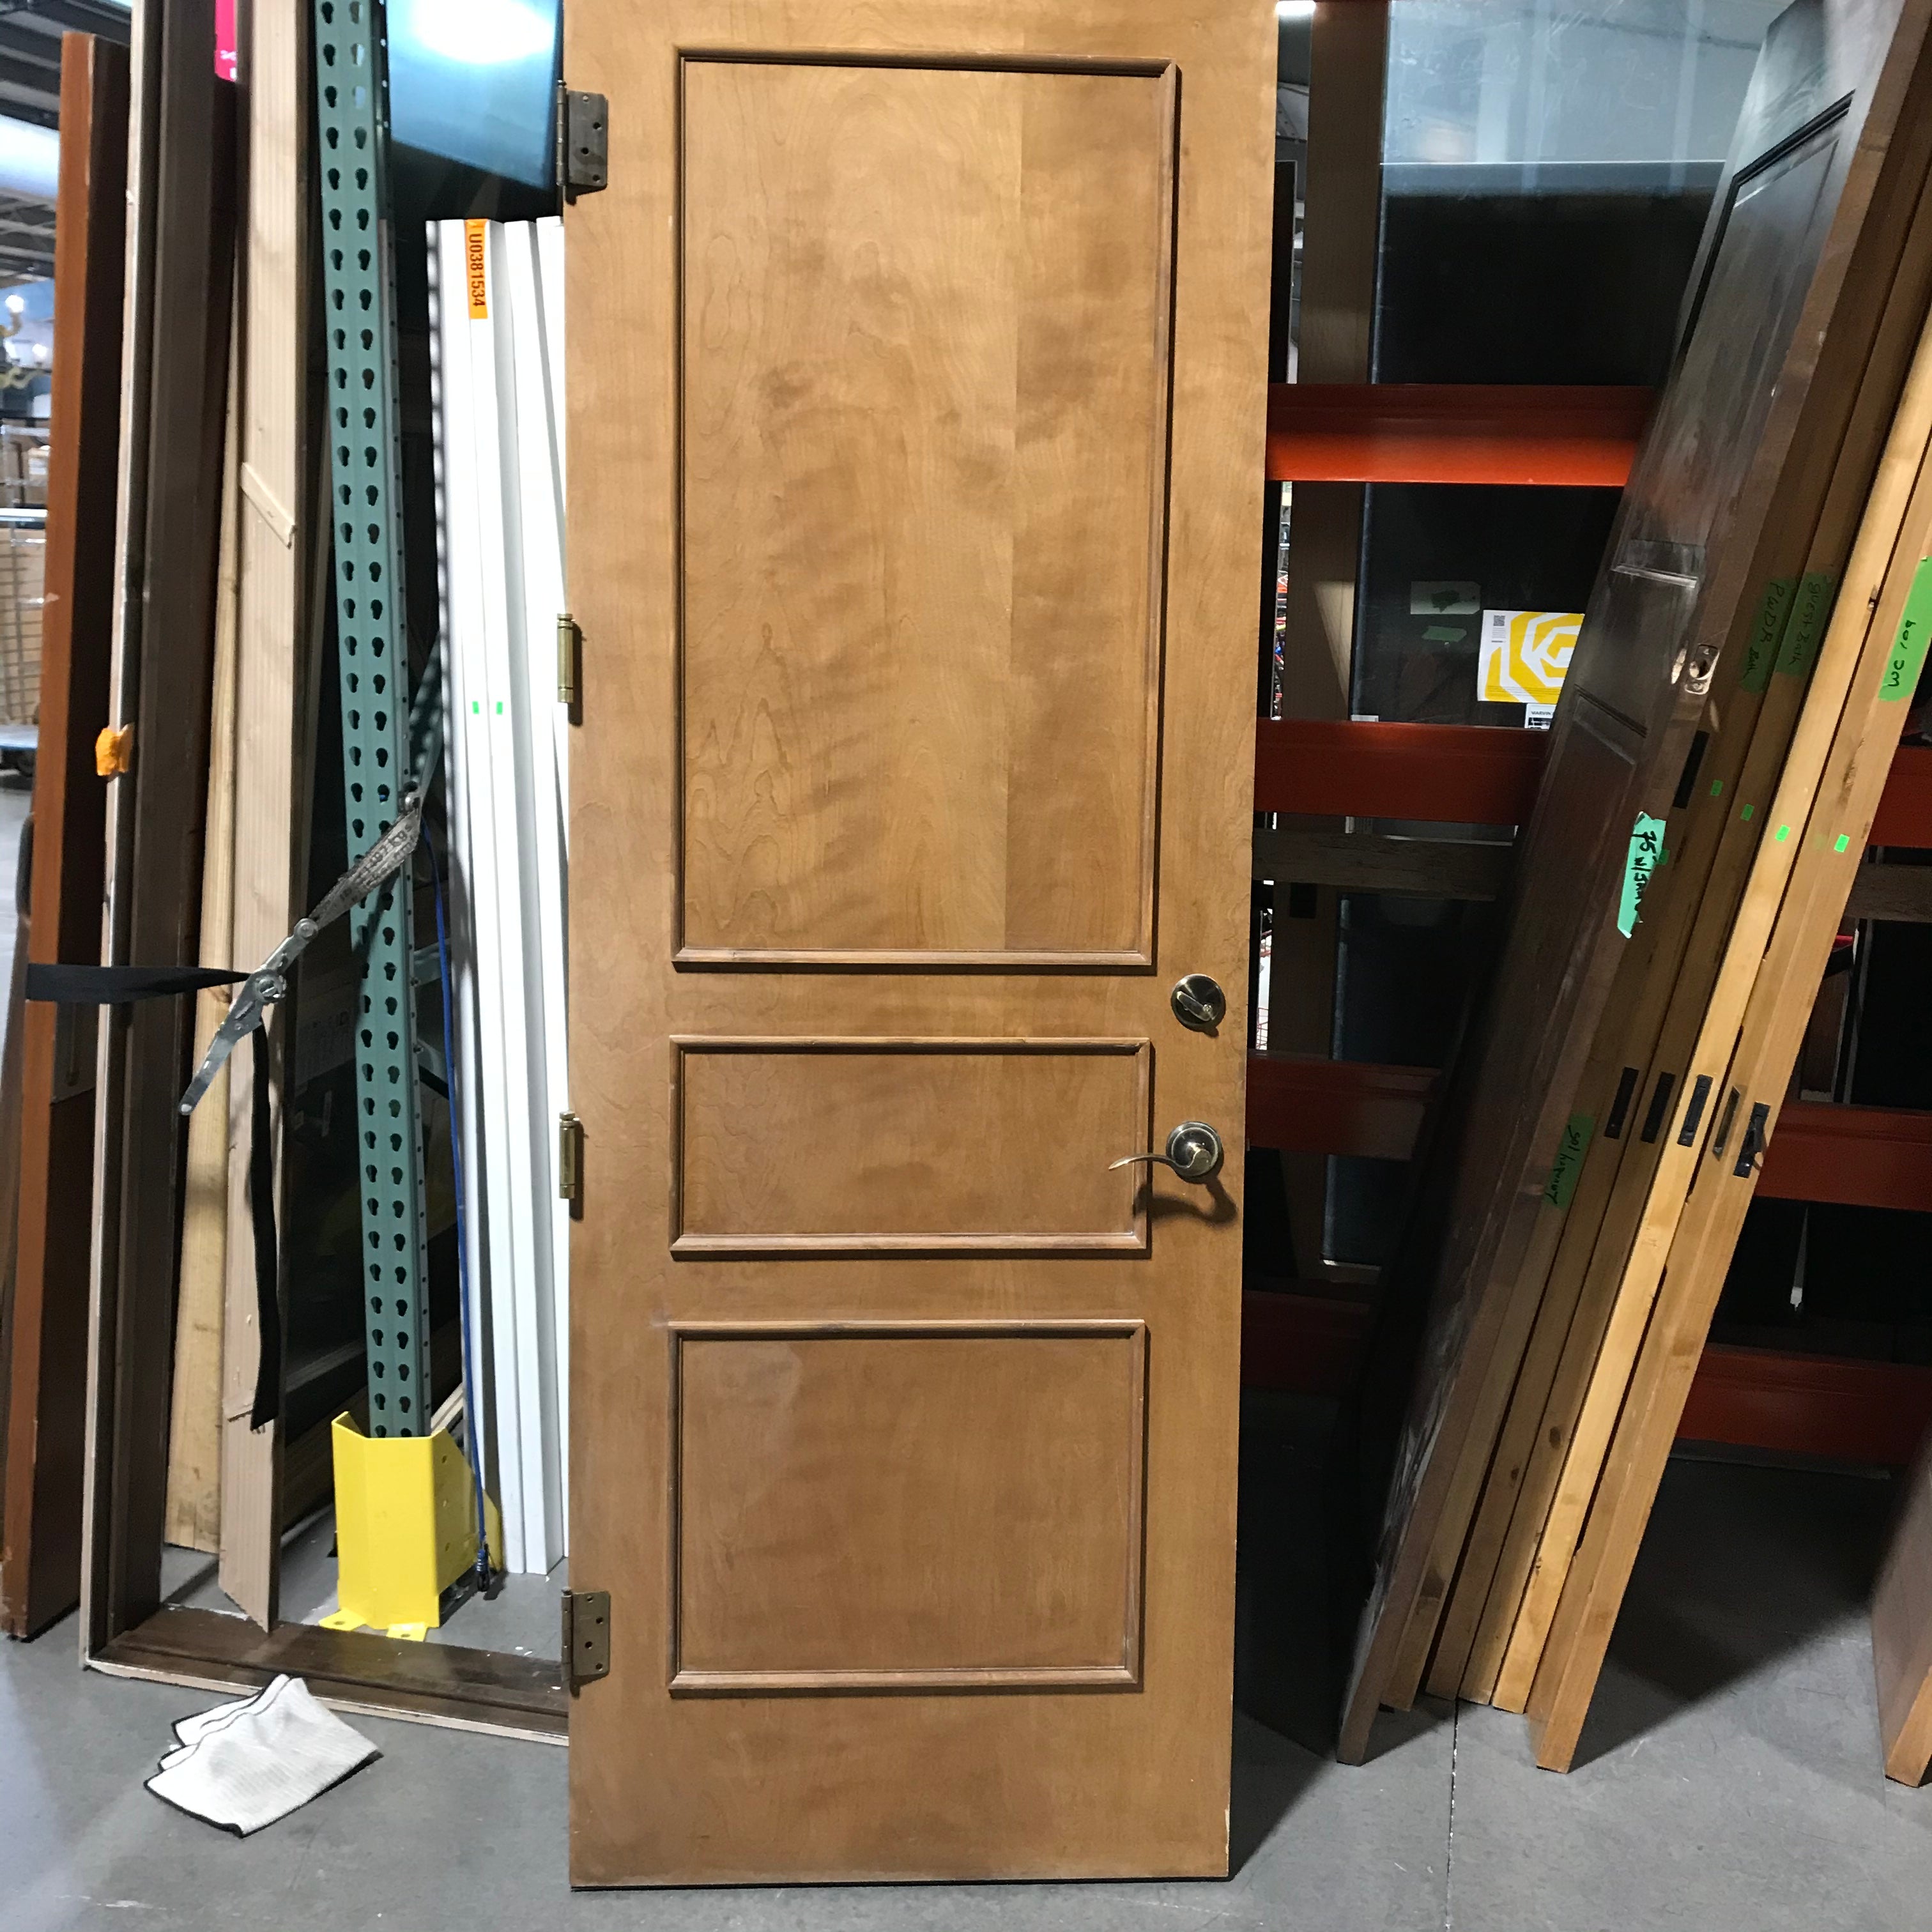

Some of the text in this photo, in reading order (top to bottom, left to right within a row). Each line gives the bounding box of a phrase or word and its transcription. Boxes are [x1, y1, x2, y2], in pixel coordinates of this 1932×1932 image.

[469, 233, 486, 306] U0381534
[1760, 582, 1784, 642] PWDR
[1888, 620, 1916, 687] WC 109
[1568, 1125, 1580, 1151] 105
